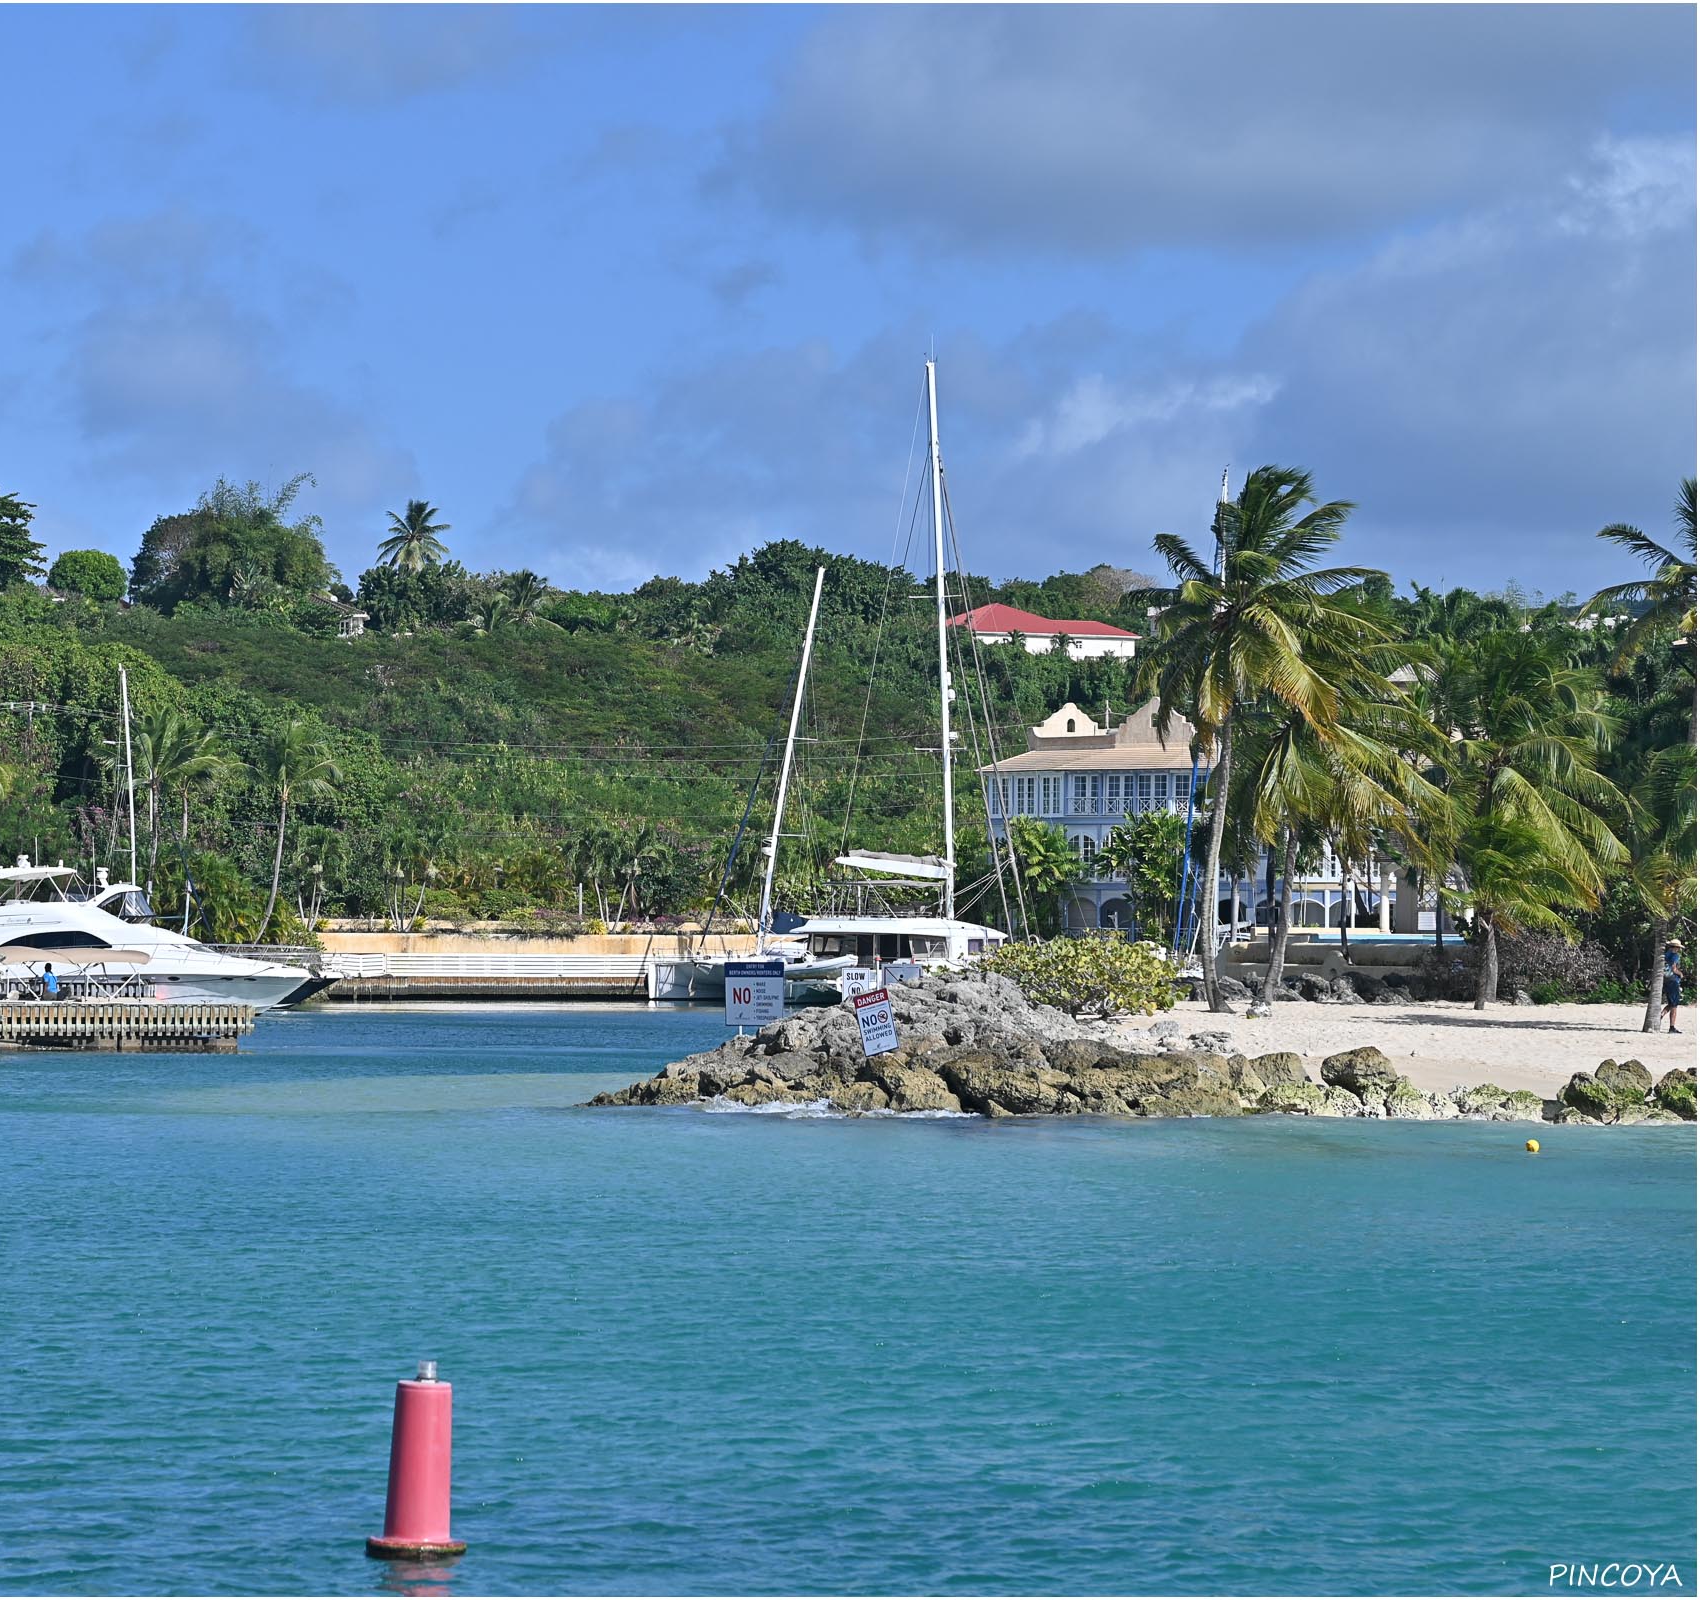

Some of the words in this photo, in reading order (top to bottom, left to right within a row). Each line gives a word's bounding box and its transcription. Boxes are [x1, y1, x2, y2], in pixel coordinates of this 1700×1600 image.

[846, 972, 865, 980] SLOW
[733, 987, 751, 1004] NO
[851, 986, 861, 995] NO
[857, 992, 885, 1007] DANGER
[861, 1014, 878, 1028] NO
[863, 1023, 892, 1036] SWIMMING
[865, 1029, 893, 1042] ALLOWED
